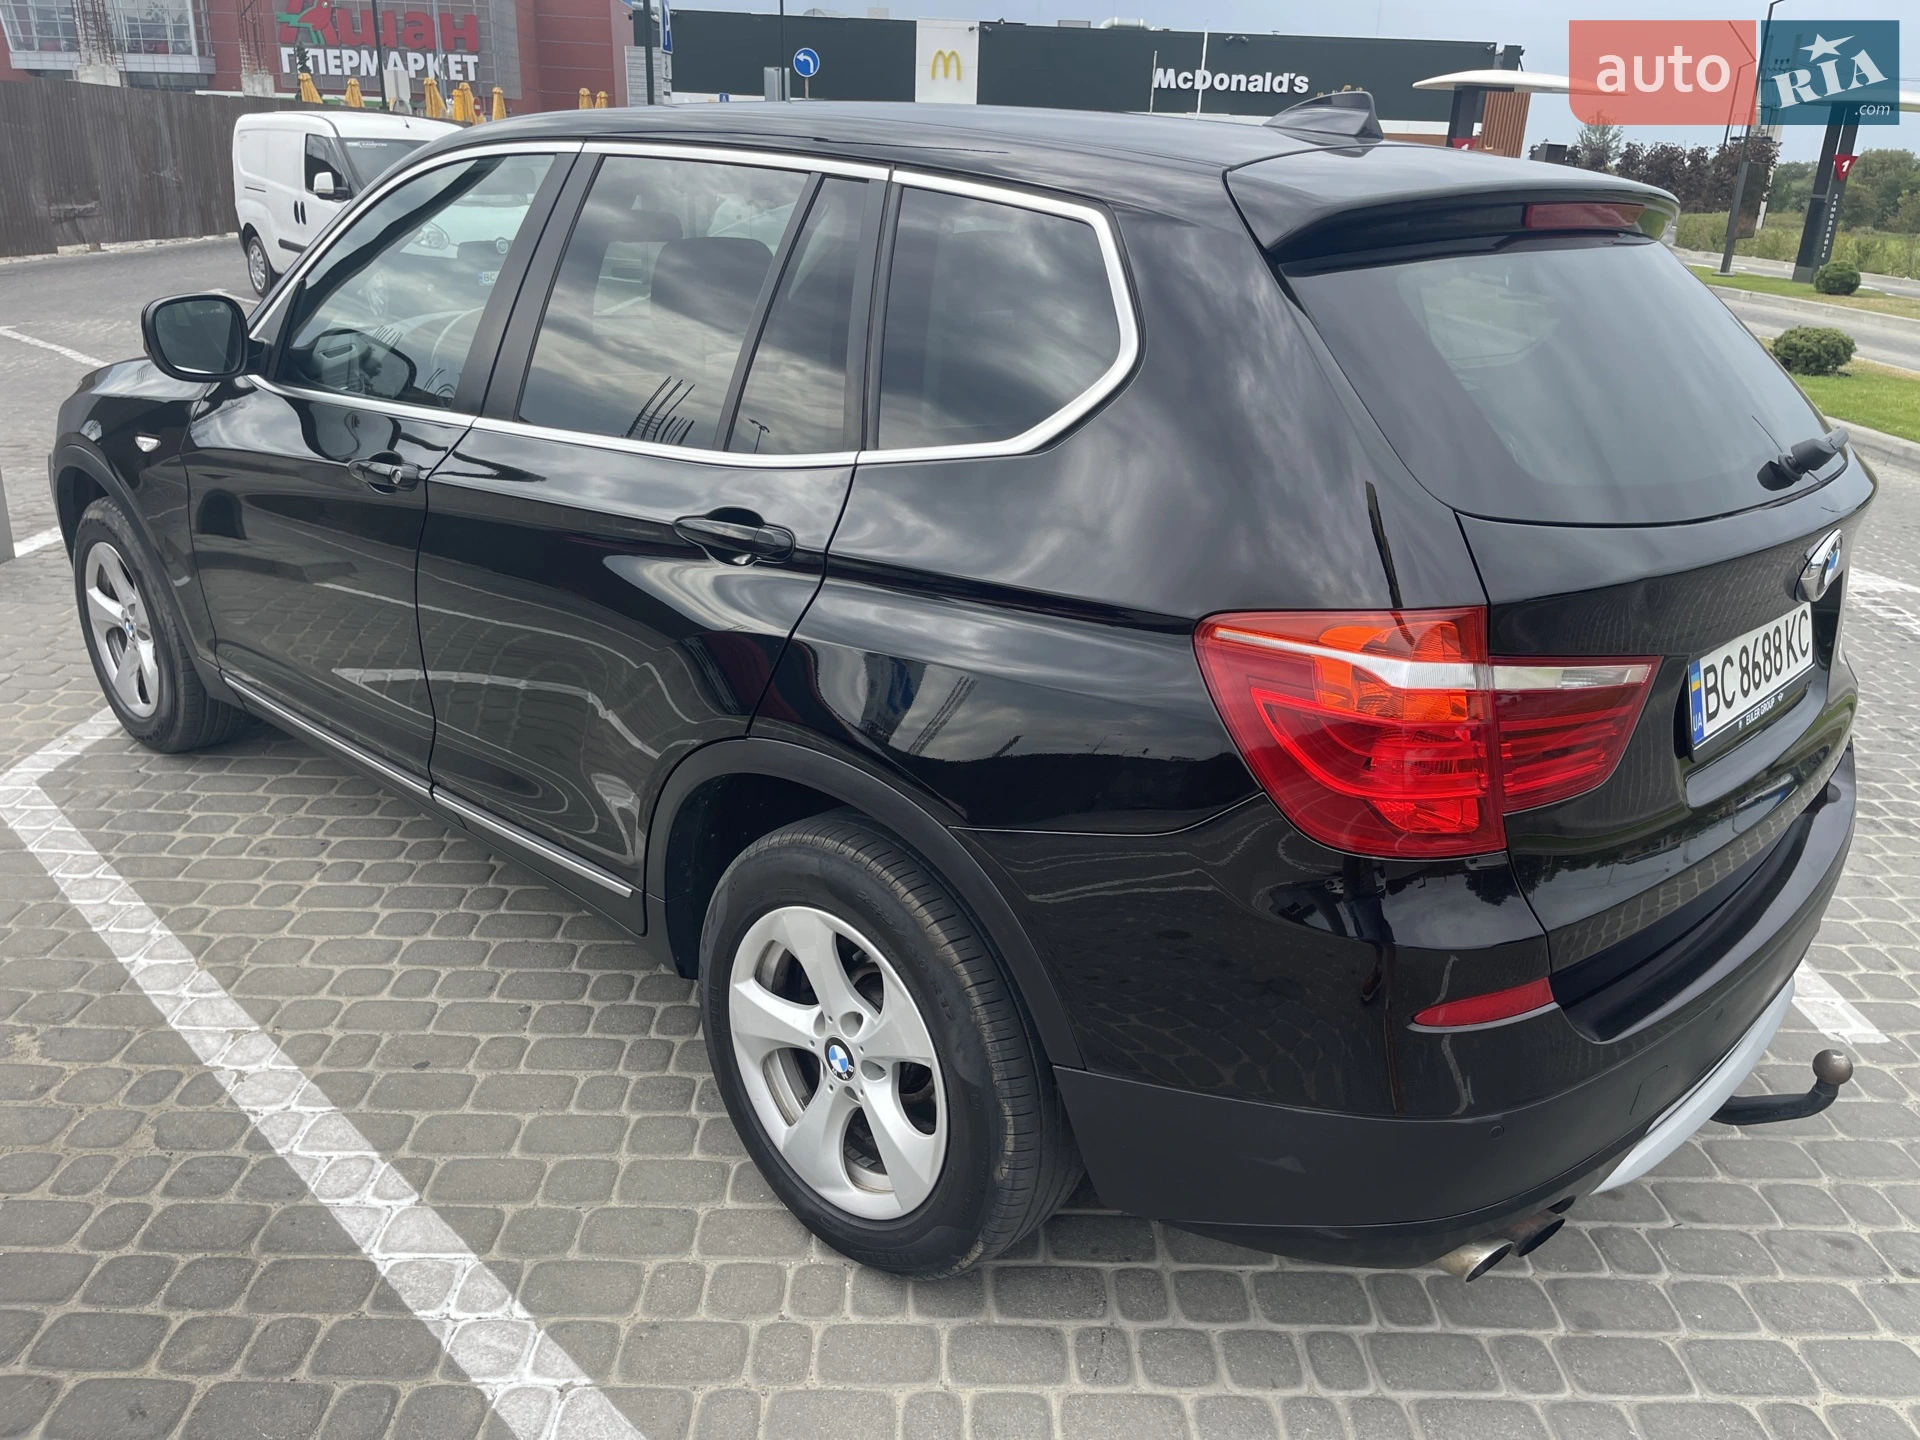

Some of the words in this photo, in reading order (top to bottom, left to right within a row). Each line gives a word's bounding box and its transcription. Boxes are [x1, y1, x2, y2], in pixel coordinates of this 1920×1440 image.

[280, 46, 479, 81] ГПЕРМАРКЕТ
[1153, 67, 1309, 94] McDonald's
[1841, 159, 1850, 173] 1
[1703, 655, 1736, 724] BC
[1738, 625, 1783, 699] 8688
[1785, 609, 1810, 670] KC
[1693, 711, 1703, 732] UA
